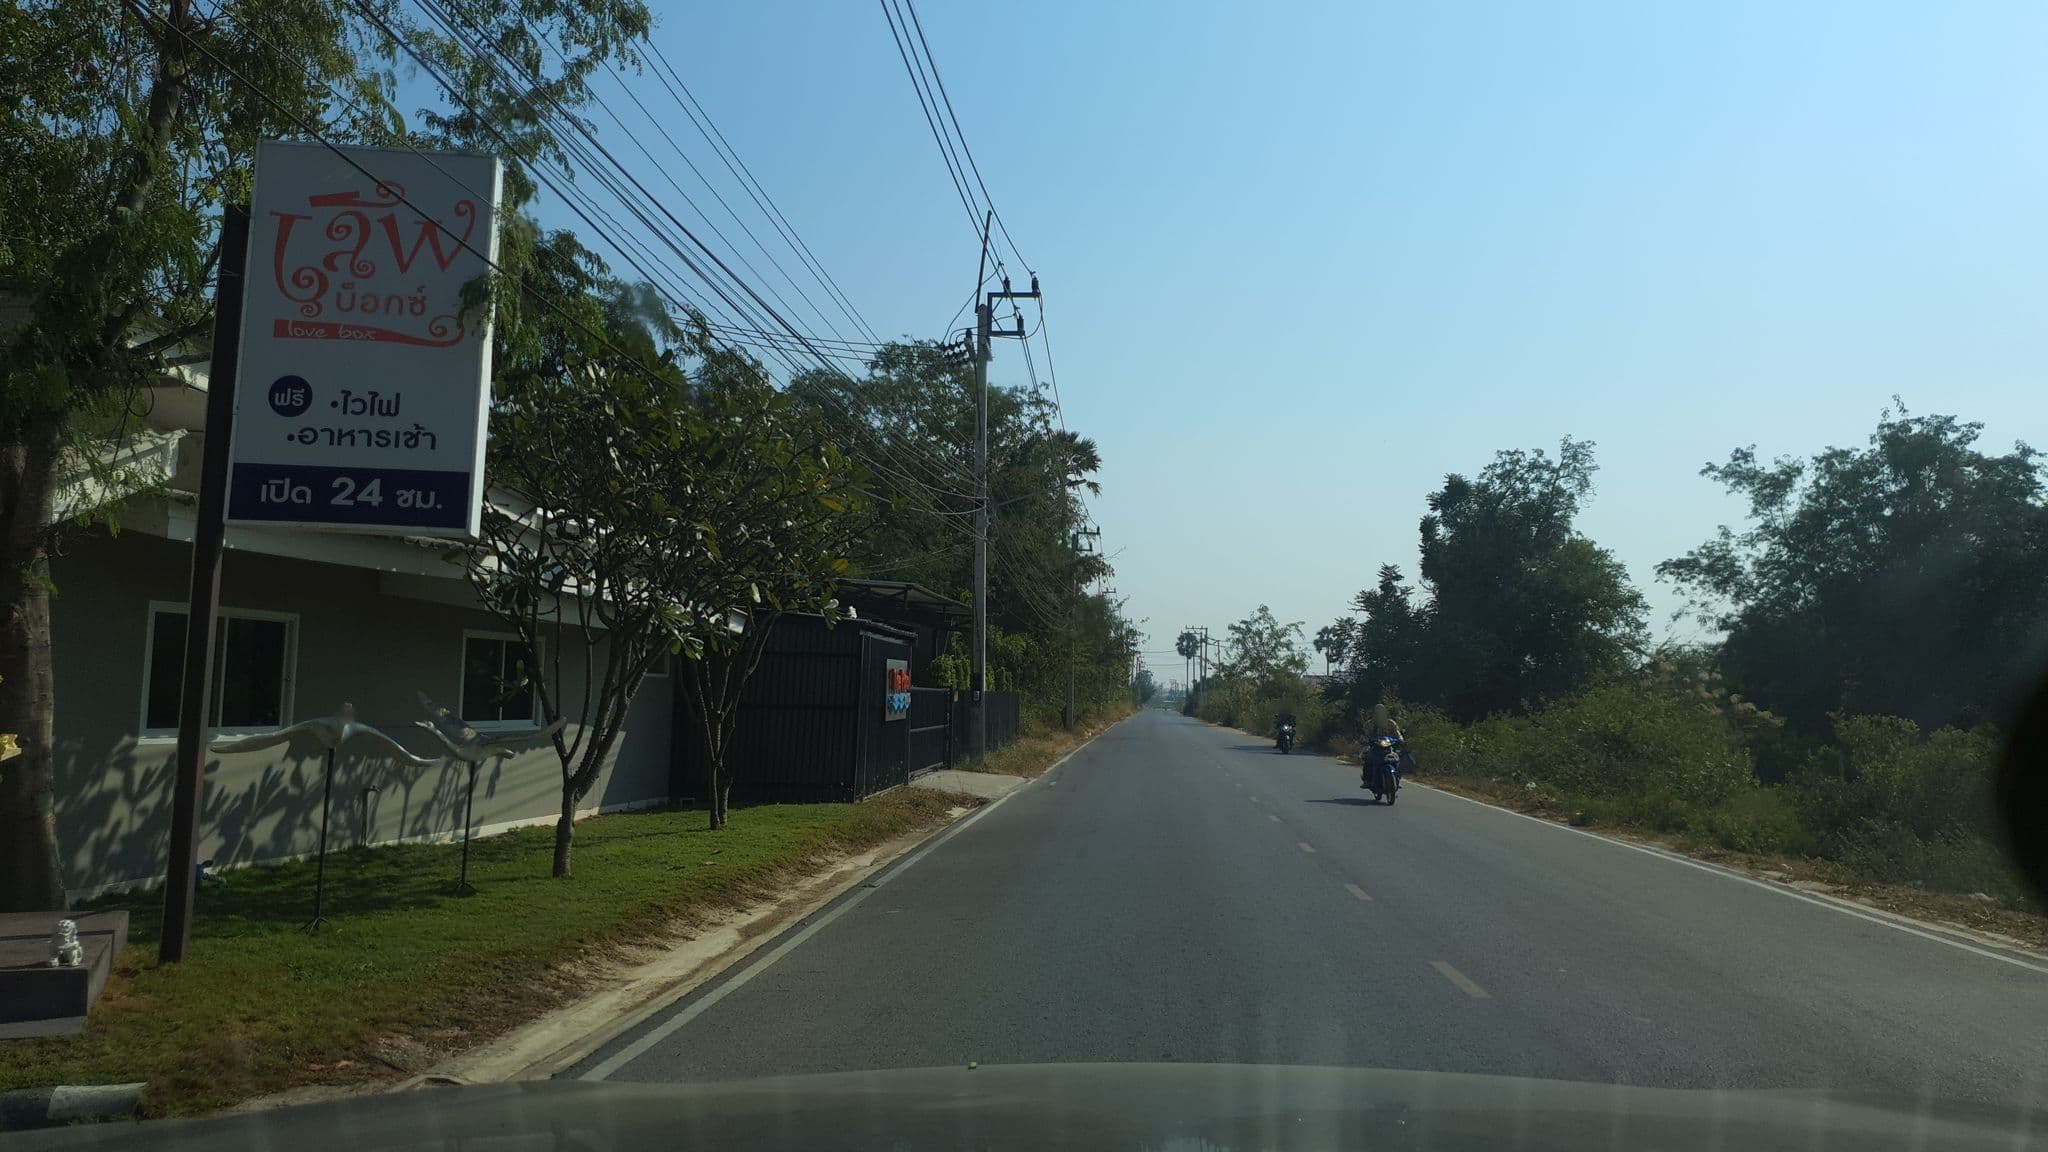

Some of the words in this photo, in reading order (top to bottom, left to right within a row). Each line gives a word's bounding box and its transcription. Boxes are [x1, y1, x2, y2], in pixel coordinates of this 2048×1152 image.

[288, 319, 328, 338] love
[338, 324, 376, 341] box
[274, 388, 305, 408] ฟรี
[260, 477, 312, 505] เปิด
[330, 476, 384, 508] 24
[395, 487, 443, 510] ชม.
